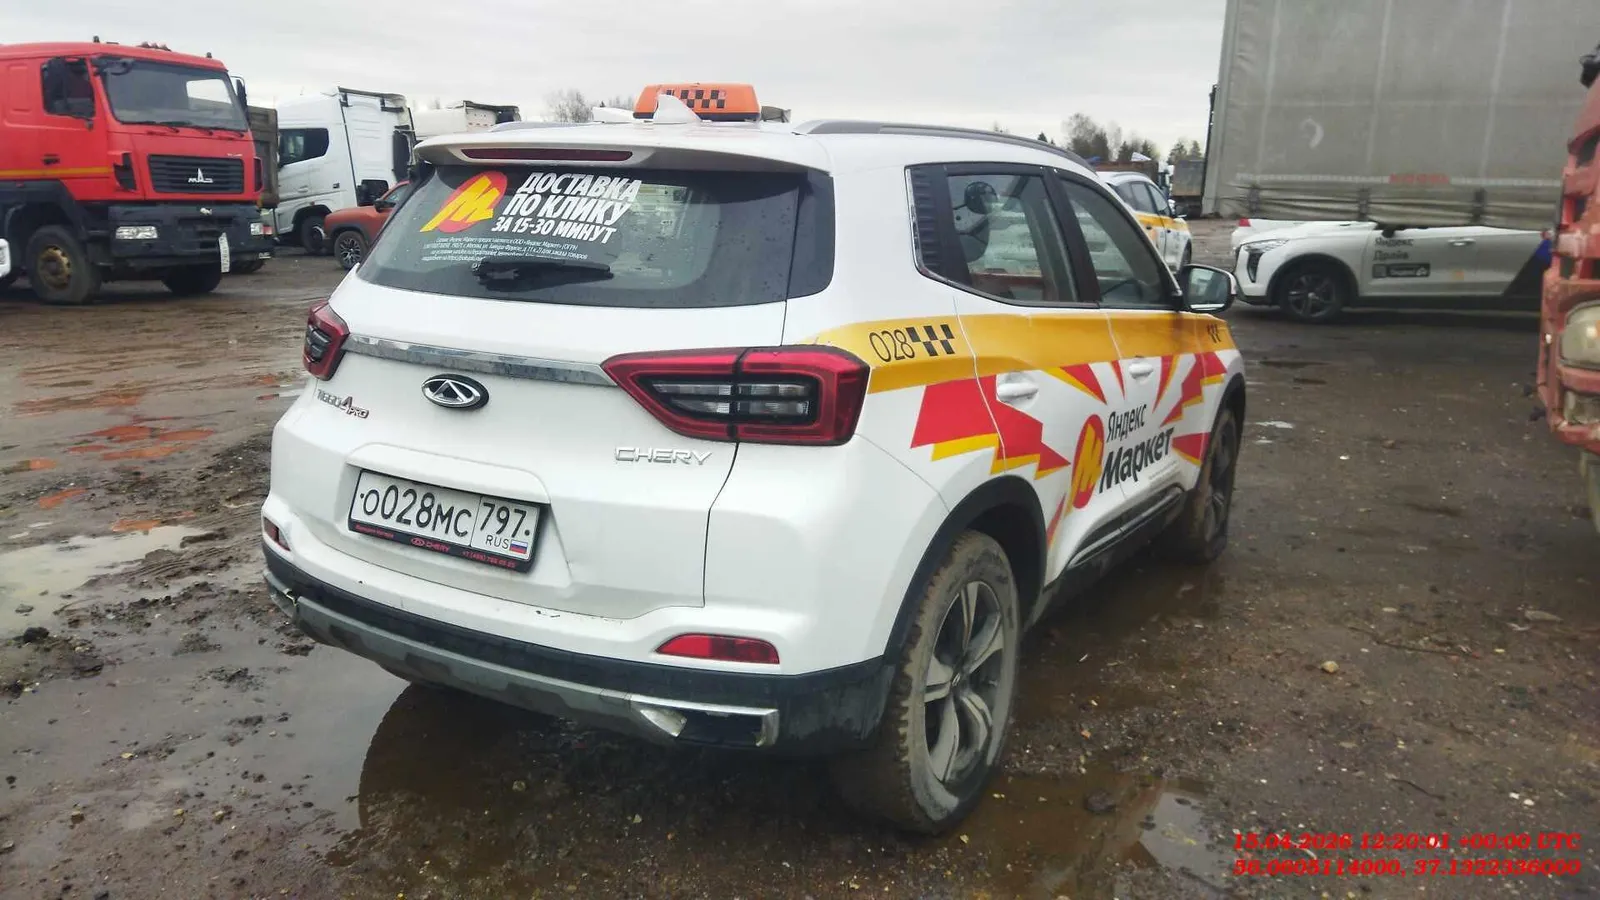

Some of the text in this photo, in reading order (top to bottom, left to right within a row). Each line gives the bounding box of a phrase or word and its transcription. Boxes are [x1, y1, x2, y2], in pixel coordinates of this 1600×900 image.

[516, 172, 642, 203] ДОСТАВКА
[502, 193, 632, 226] ПО КЛИКУ
[491, 216, 617, 244] ЗА 15-30 МИНУТ
[869, 328, 915, 362] 028
[1106, 403, 1147, 443] Яндекс
[615, 447, 713, 466] CHERY
[1098, 427, 1175, 494] Маркет
[480, 502, 527, 538] 797
[485, 534, 510, 550] RUS
